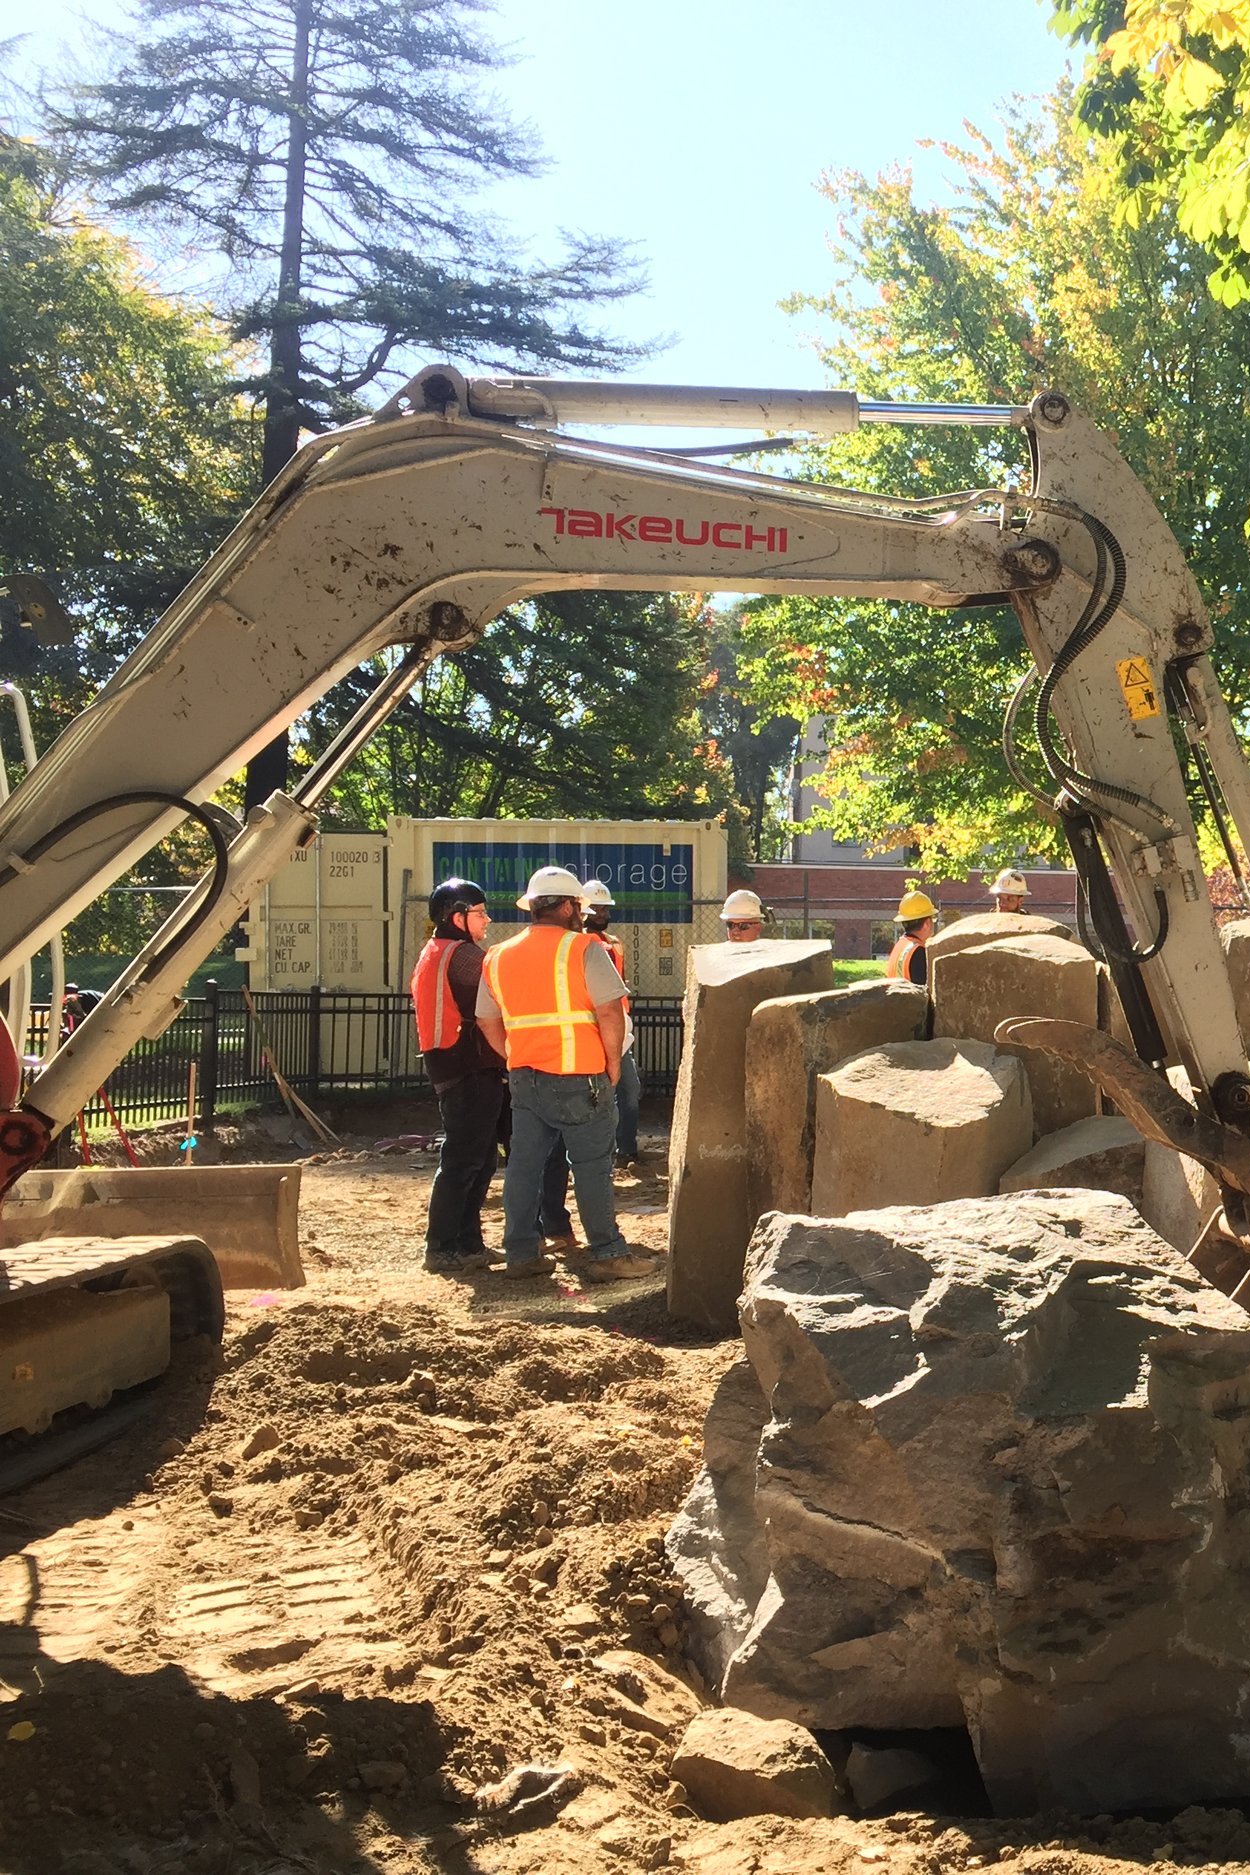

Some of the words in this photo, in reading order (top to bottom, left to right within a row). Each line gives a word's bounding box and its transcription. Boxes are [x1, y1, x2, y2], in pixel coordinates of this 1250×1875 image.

[330, 851, 369, 863] 100020
[373, 851, 381, 863] 3
[329, 866, 354, 877] 22G1
[564, 857, 688, 891] storage
[275, 935, 296, 947] TARE
[274, 949, 293, 960] NET
[274, 961, 289, 973] CU.
[291, 961, 312, 973] CAP.
